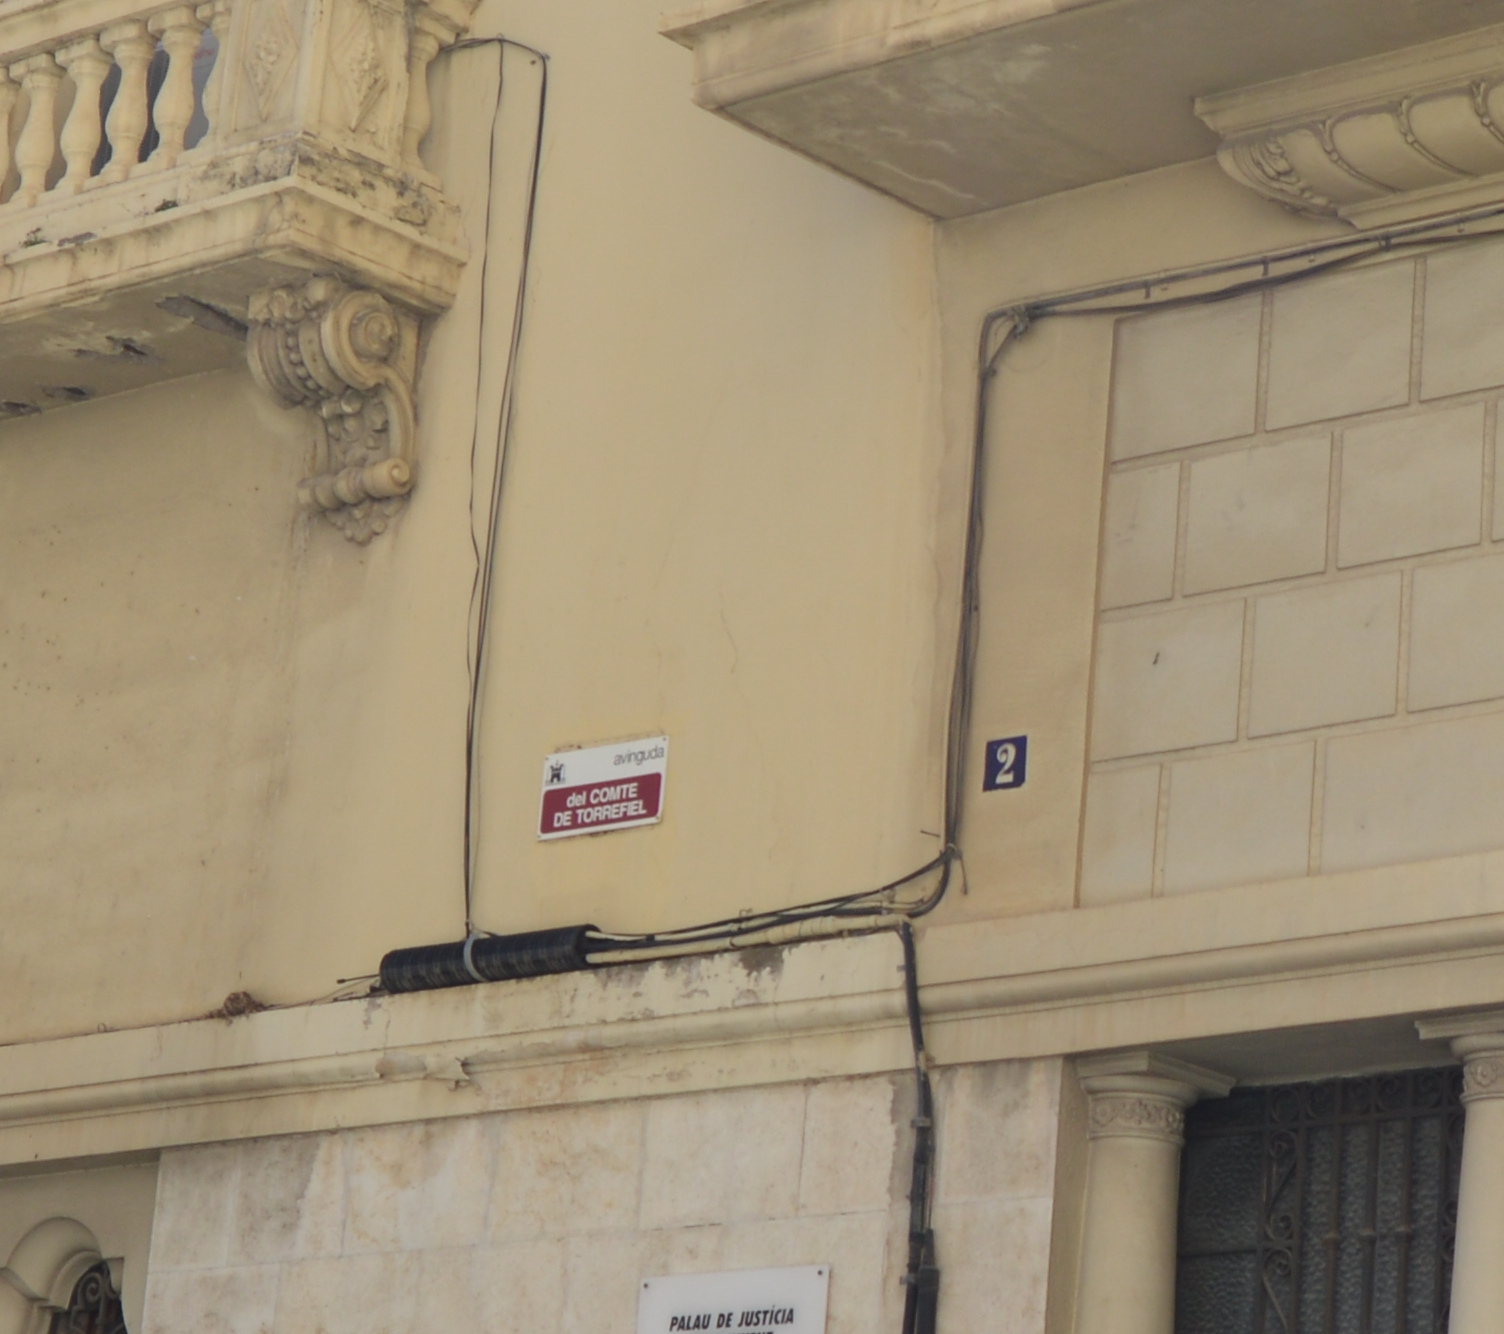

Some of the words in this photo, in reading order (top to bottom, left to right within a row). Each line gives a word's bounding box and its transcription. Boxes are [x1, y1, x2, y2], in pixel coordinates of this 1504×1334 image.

[613, 745, 665, 766] avinguda
[995, 742, 1016, 785] 2
[566, 791, 586, 808] del
[589, 782, 638, 804] COMTE
[553, 810, 573, 828] DE
[576, 800, 647, 824] TORREFIEL
[669, 1313, 712, 1332] PALAU
[716, 1312, 733, 1328] DE
[737, 1304, 794, 1327] JUSTÍCIA
